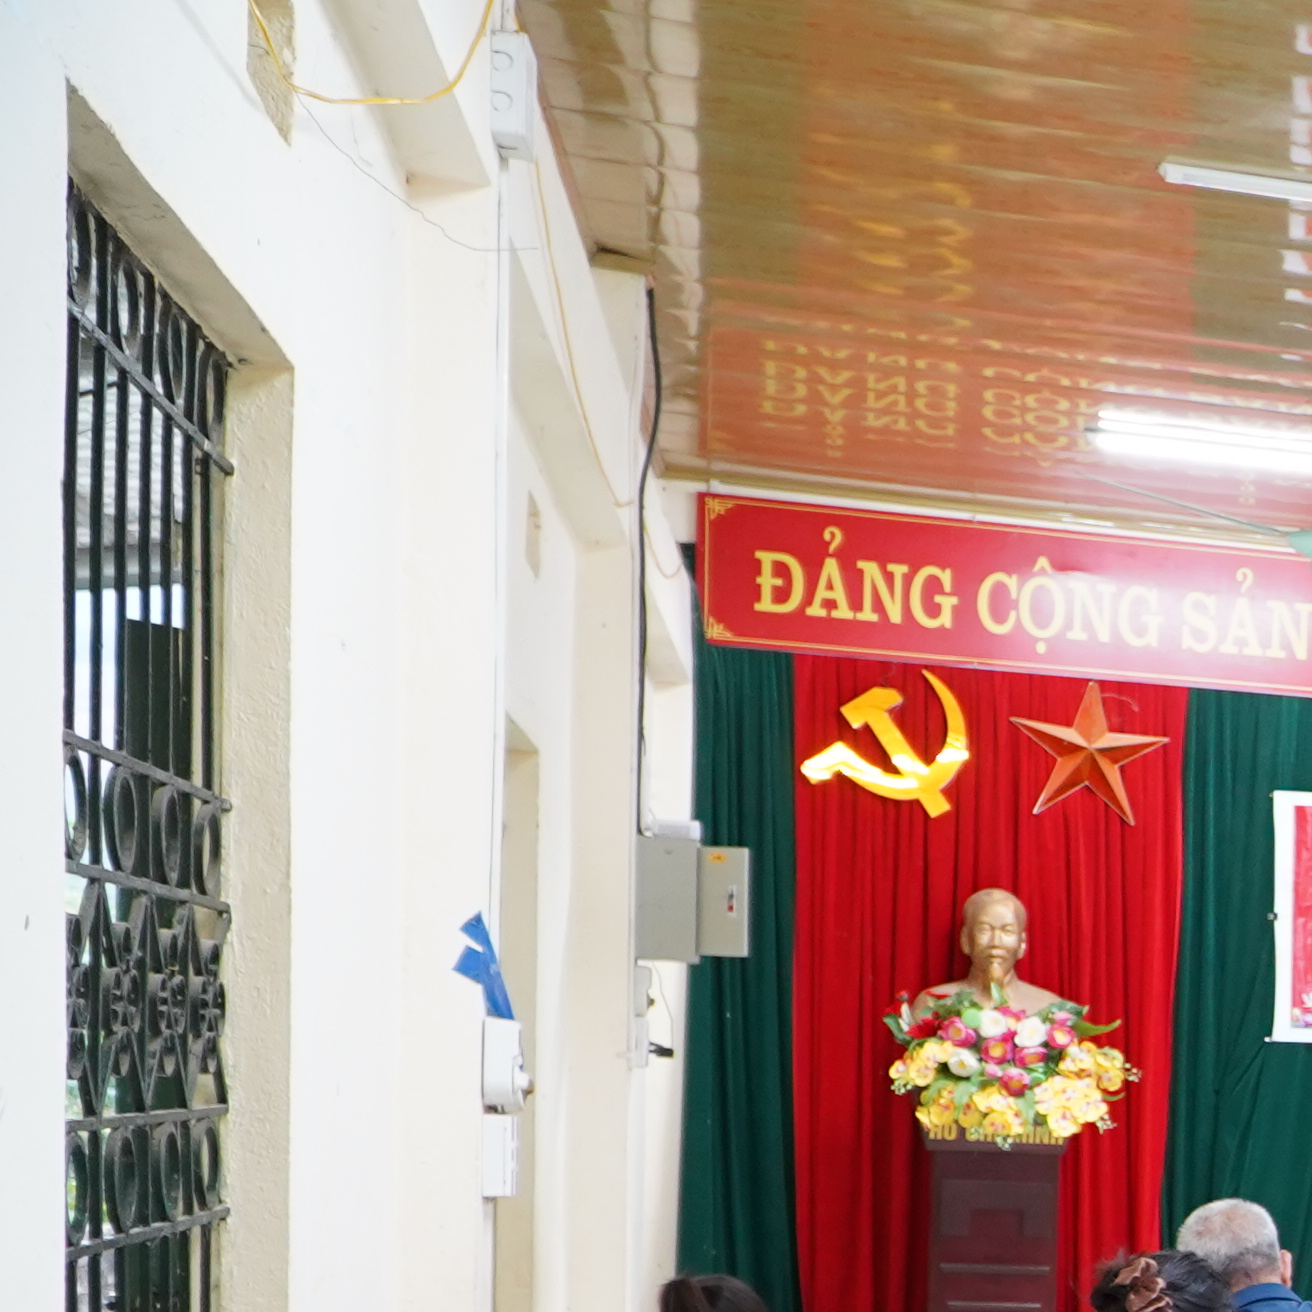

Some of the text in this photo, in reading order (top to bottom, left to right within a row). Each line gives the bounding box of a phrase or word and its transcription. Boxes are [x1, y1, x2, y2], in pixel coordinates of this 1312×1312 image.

[753, 526, 957, 630] ĐẢNG
[977, 556, 1162, 654] CỘNG
[1181, 567, 1312, 661] SẢN
